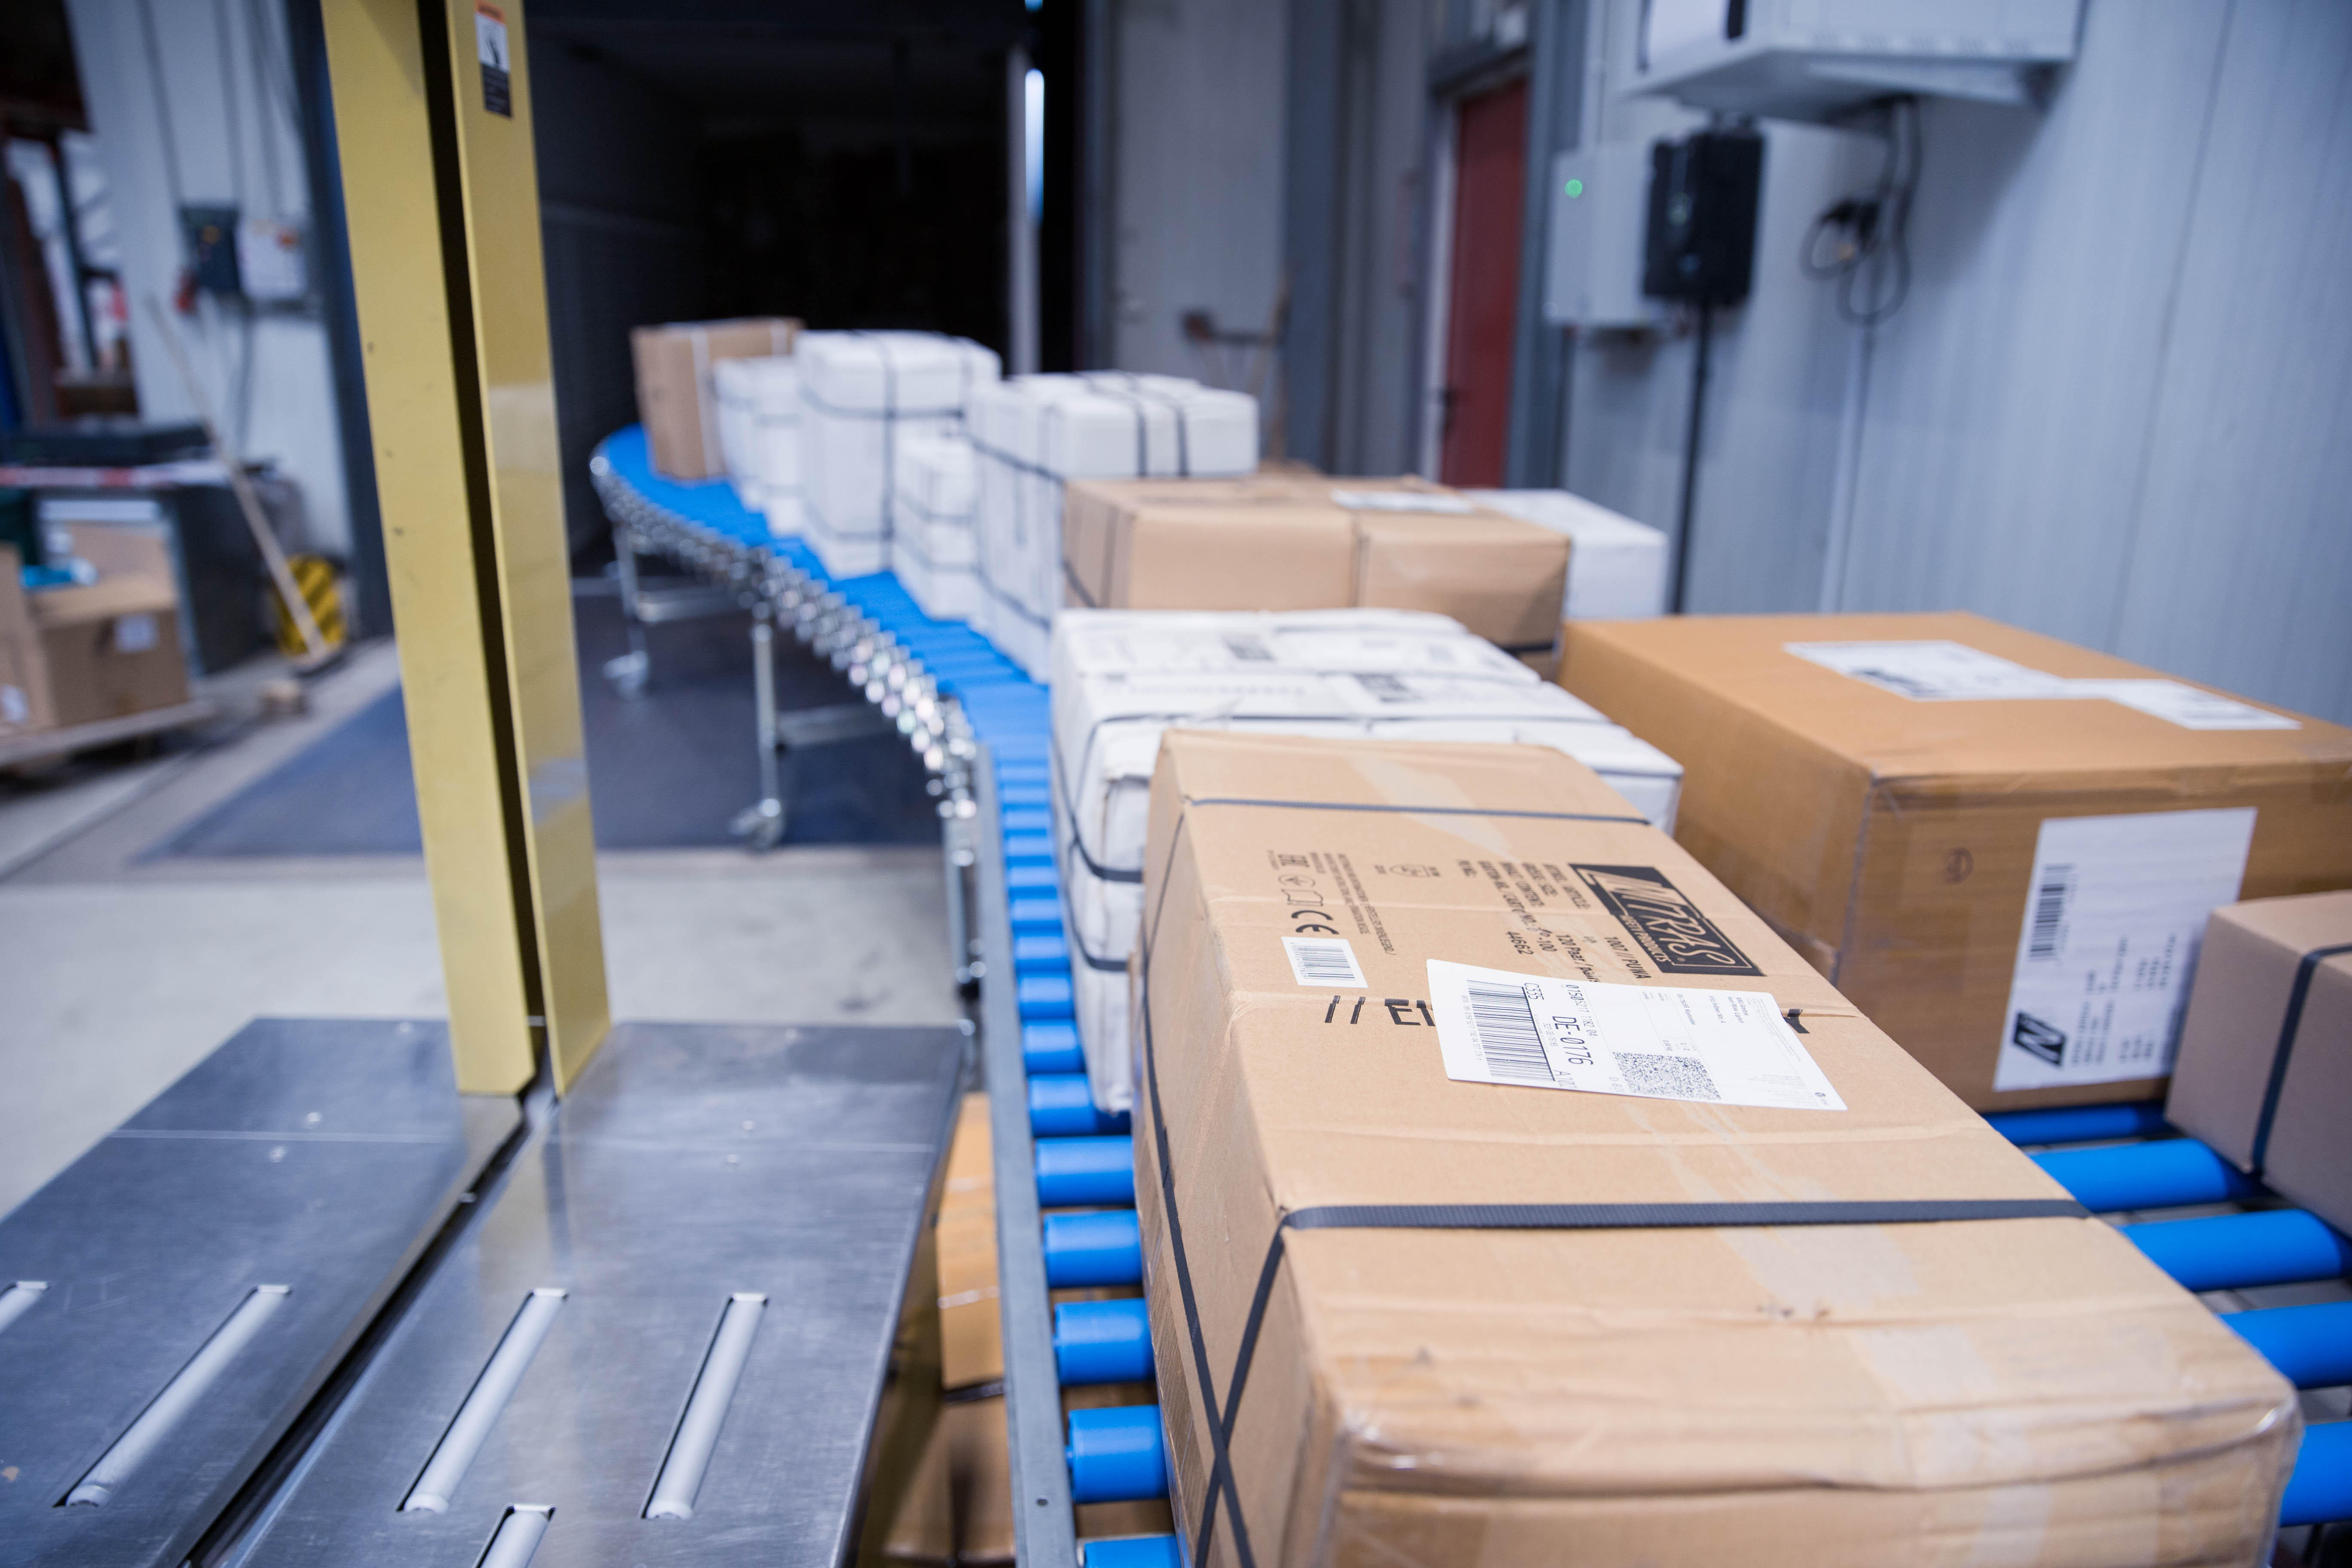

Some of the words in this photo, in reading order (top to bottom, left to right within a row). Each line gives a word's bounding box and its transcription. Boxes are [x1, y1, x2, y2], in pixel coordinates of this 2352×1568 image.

[1507, 931, 1534, 955] 44662
[1556, 934, 1576, 947] 120
[1568, 946, 1588, 962] Paar
[1605, 936, 1628, 952] 1007
[1615, 951, 1634, 962] //
[1623, 959, 1652, 979] PUWA
[1524, 983, 1544, 1001] C335
[1740, 1004, 1750, 1015] GmbH
[1553, 1016, 1593, 1065] DE-0176
